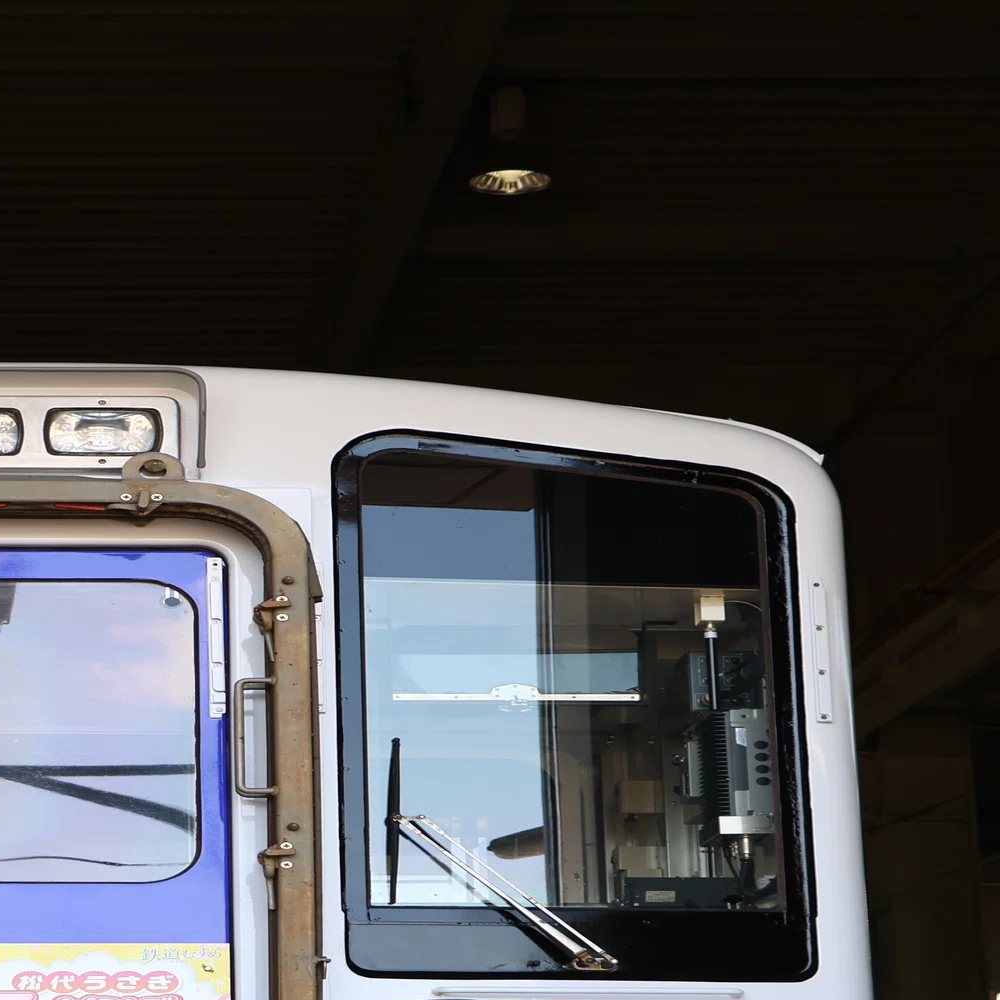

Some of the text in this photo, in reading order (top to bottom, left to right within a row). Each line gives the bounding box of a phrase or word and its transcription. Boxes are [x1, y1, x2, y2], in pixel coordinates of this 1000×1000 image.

[142, 948, 222, 964] 鉄道むすめ
[18, 974, 175, 991] 松代うさぎ
